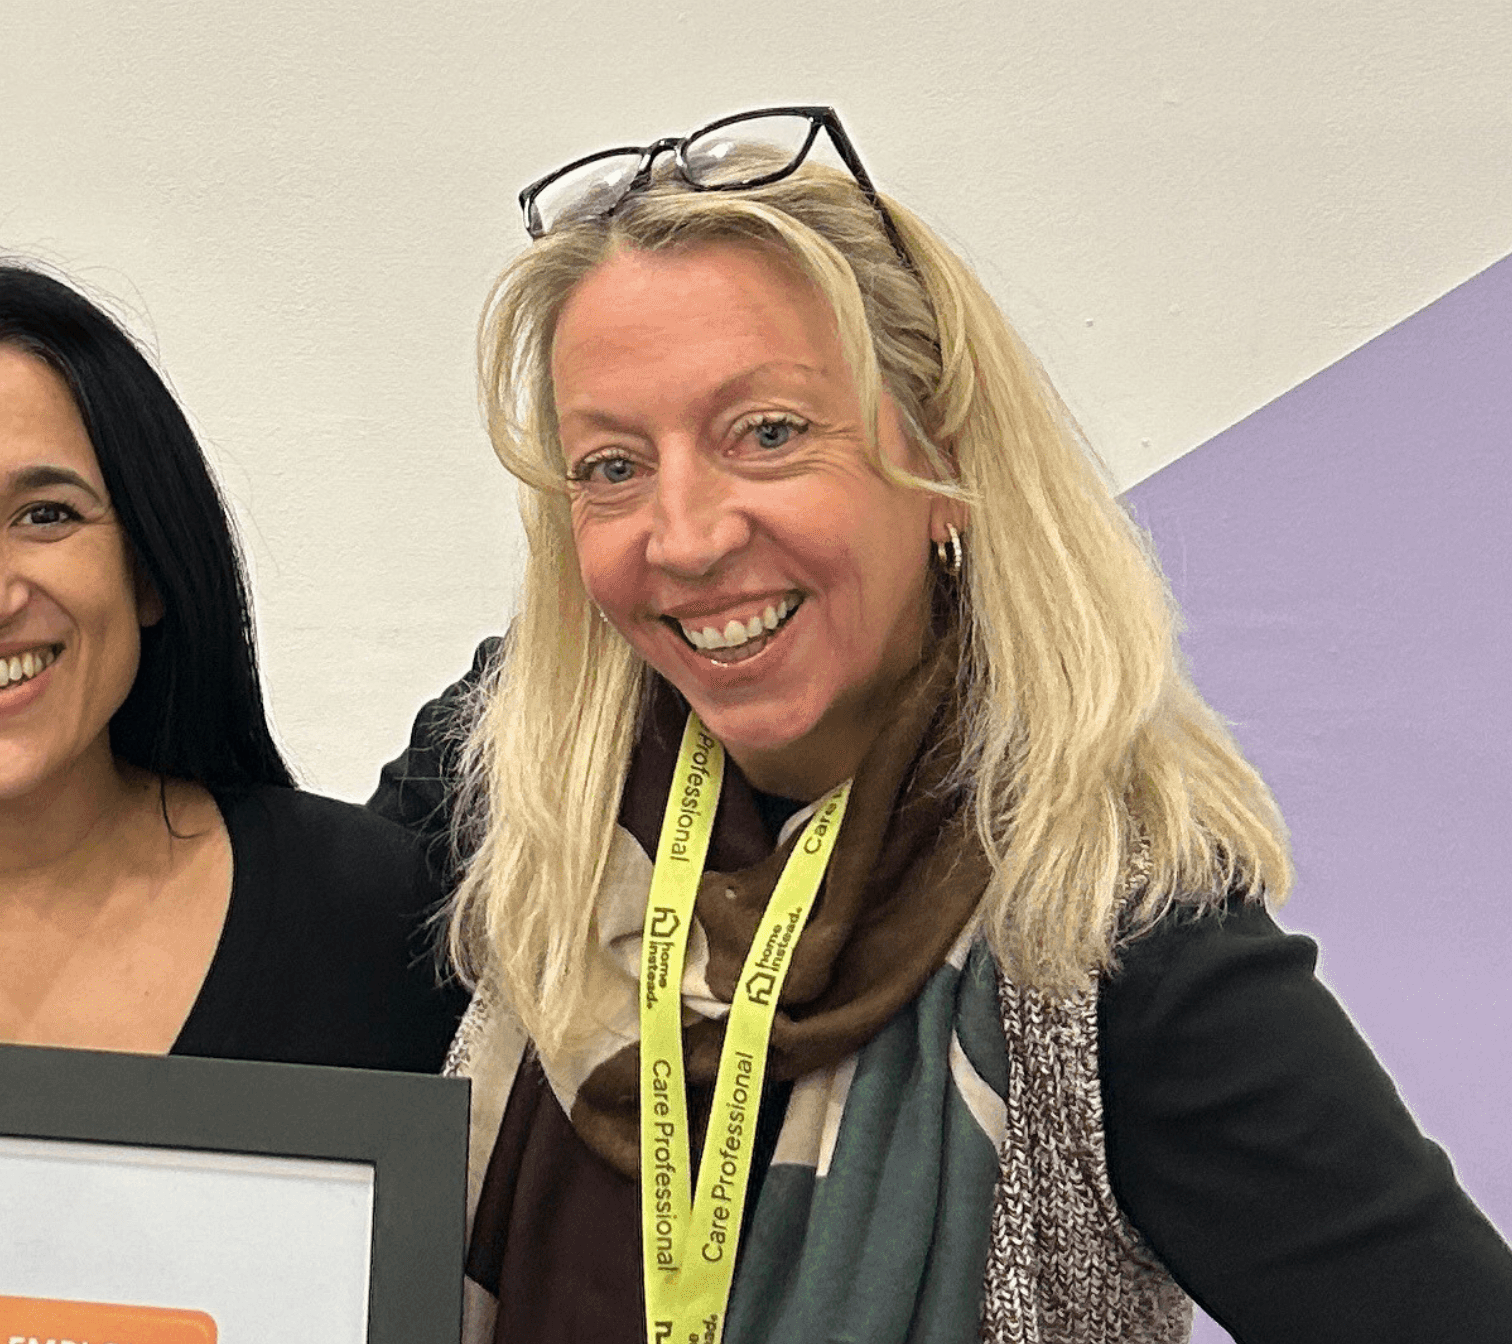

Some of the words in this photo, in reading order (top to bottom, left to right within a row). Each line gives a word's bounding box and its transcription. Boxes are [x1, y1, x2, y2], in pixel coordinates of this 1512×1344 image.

[670, 731, 715, 862] Professional
[803, 802, 837, 854] Care
[658, 941, 675, 989] home
[755, 924, 782, 970] home
[652, 1059, 672, 1116] Care
[711, 1051, 754, 1201] Professional
[654, 1121, 680, 1272] Professional
[701, 1206, 730, 1263] Care
